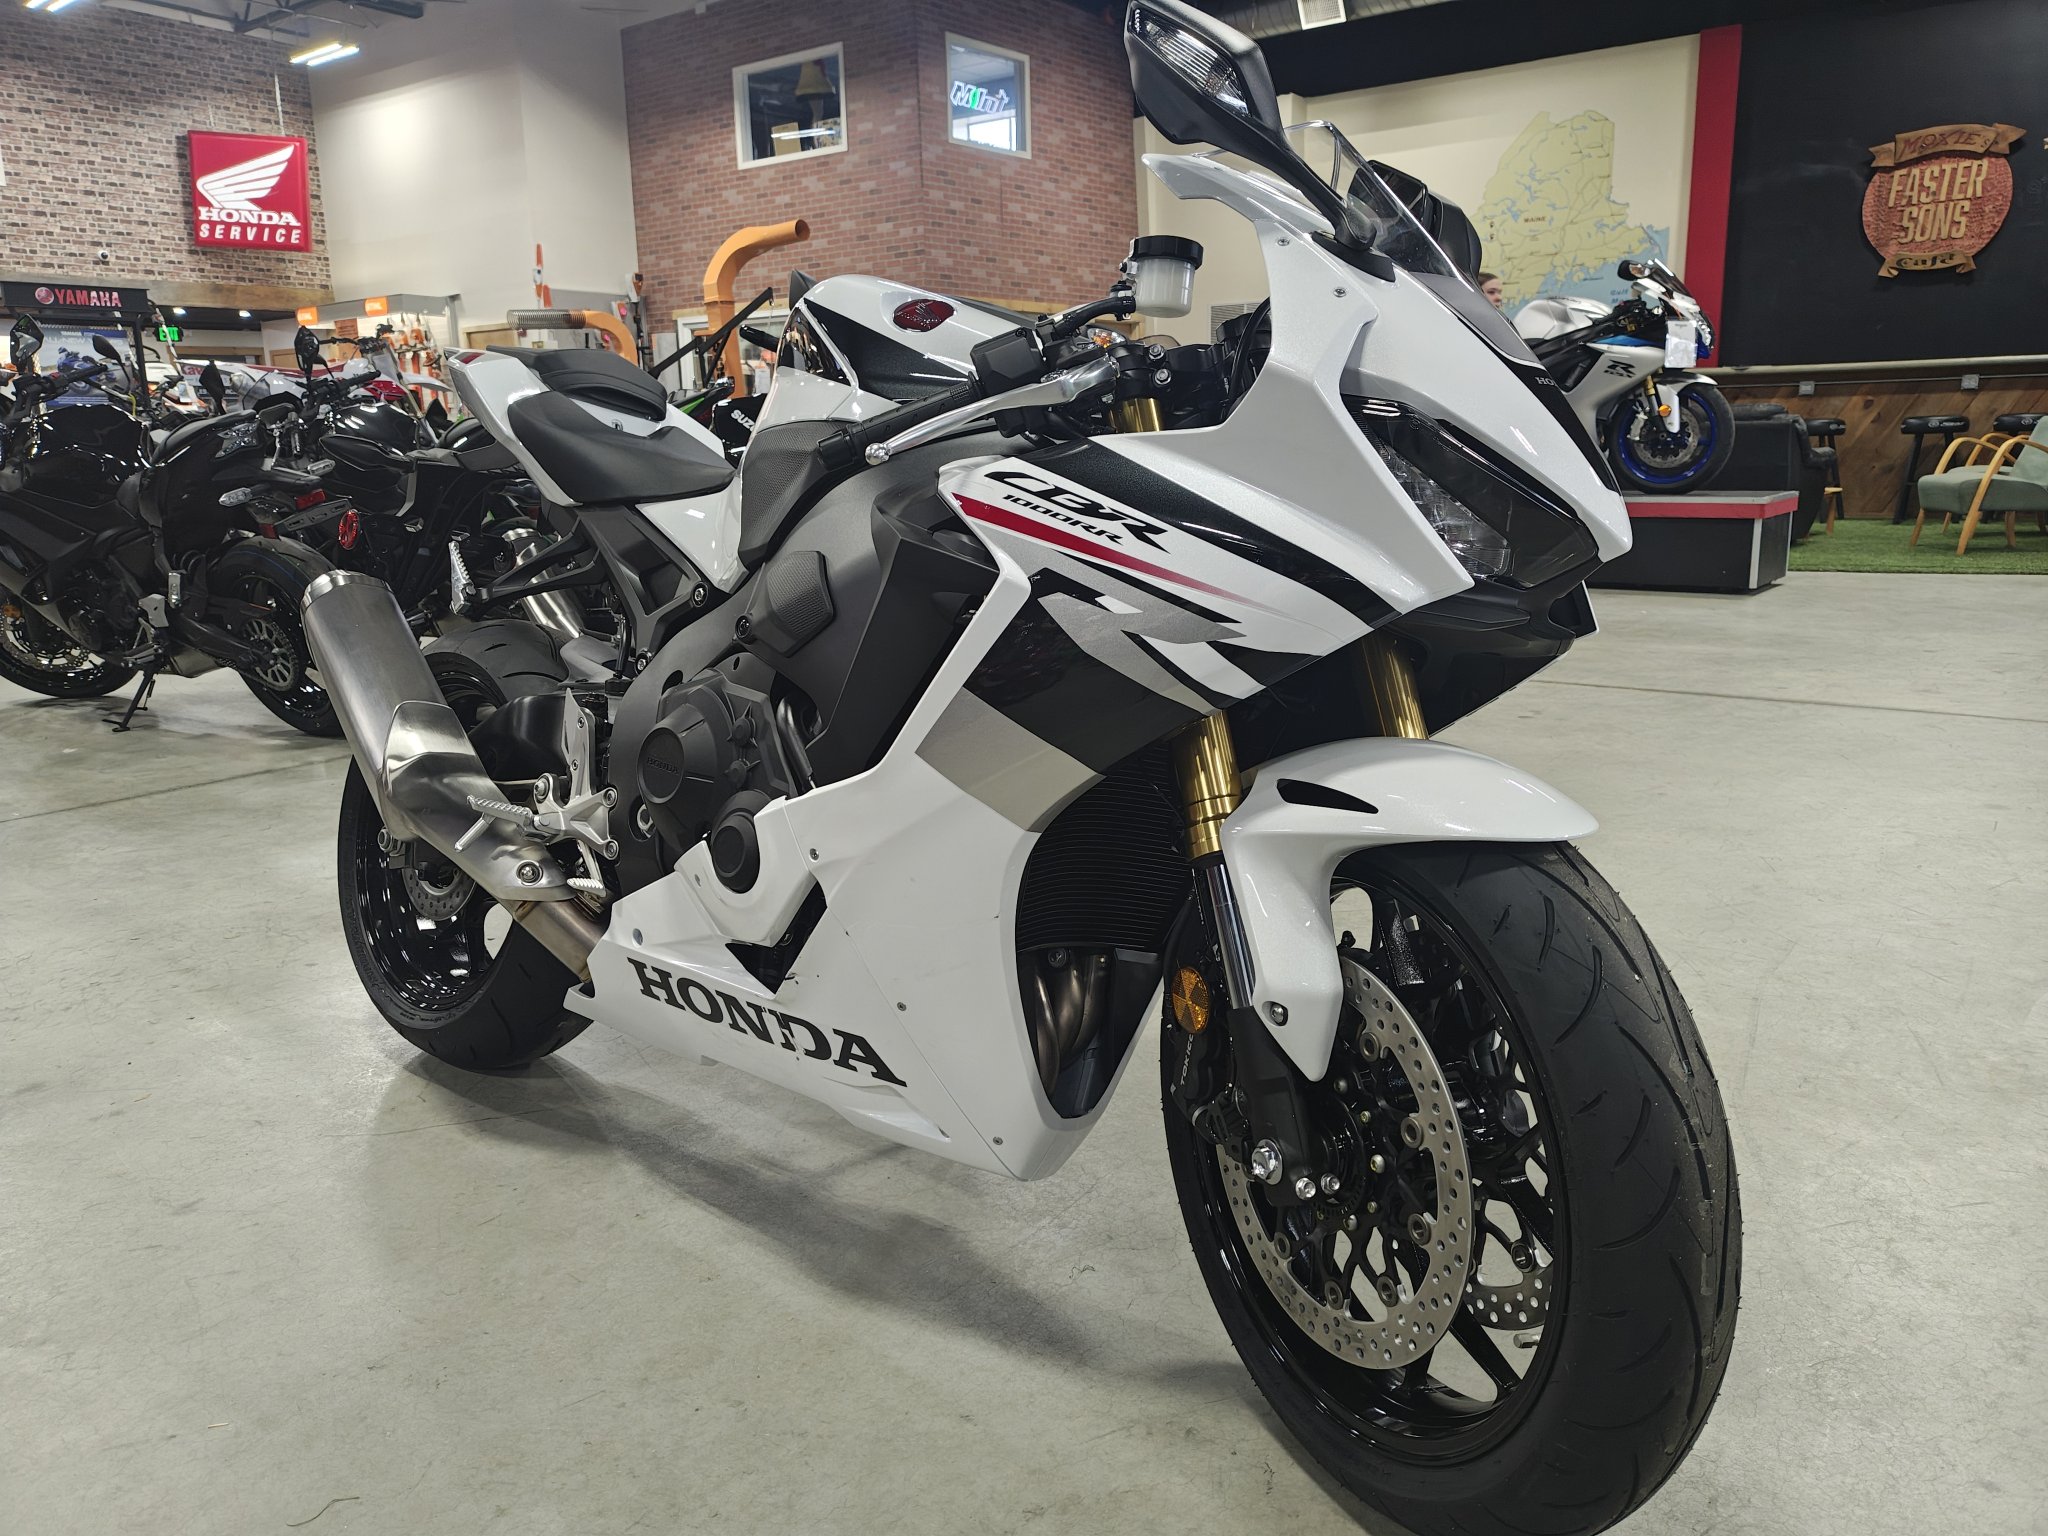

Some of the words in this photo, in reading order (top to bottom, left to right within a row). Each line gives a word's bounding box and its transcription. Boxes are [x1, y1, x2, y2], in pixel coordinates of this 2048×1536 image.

[1888, 159, 1989, 208] FASTER
[198, 206, 301, 226] HONDA
[199, 223, 301, 244] SERVICE
[1898, 201, 1970, 244] SONS
[55, 288, 122, 307] YAMAHA
[984, 471, 1171, 554] CBR
[1002, 494, 1123, 546] 1000RR
[626, 956, 907, 1087] HONDA
